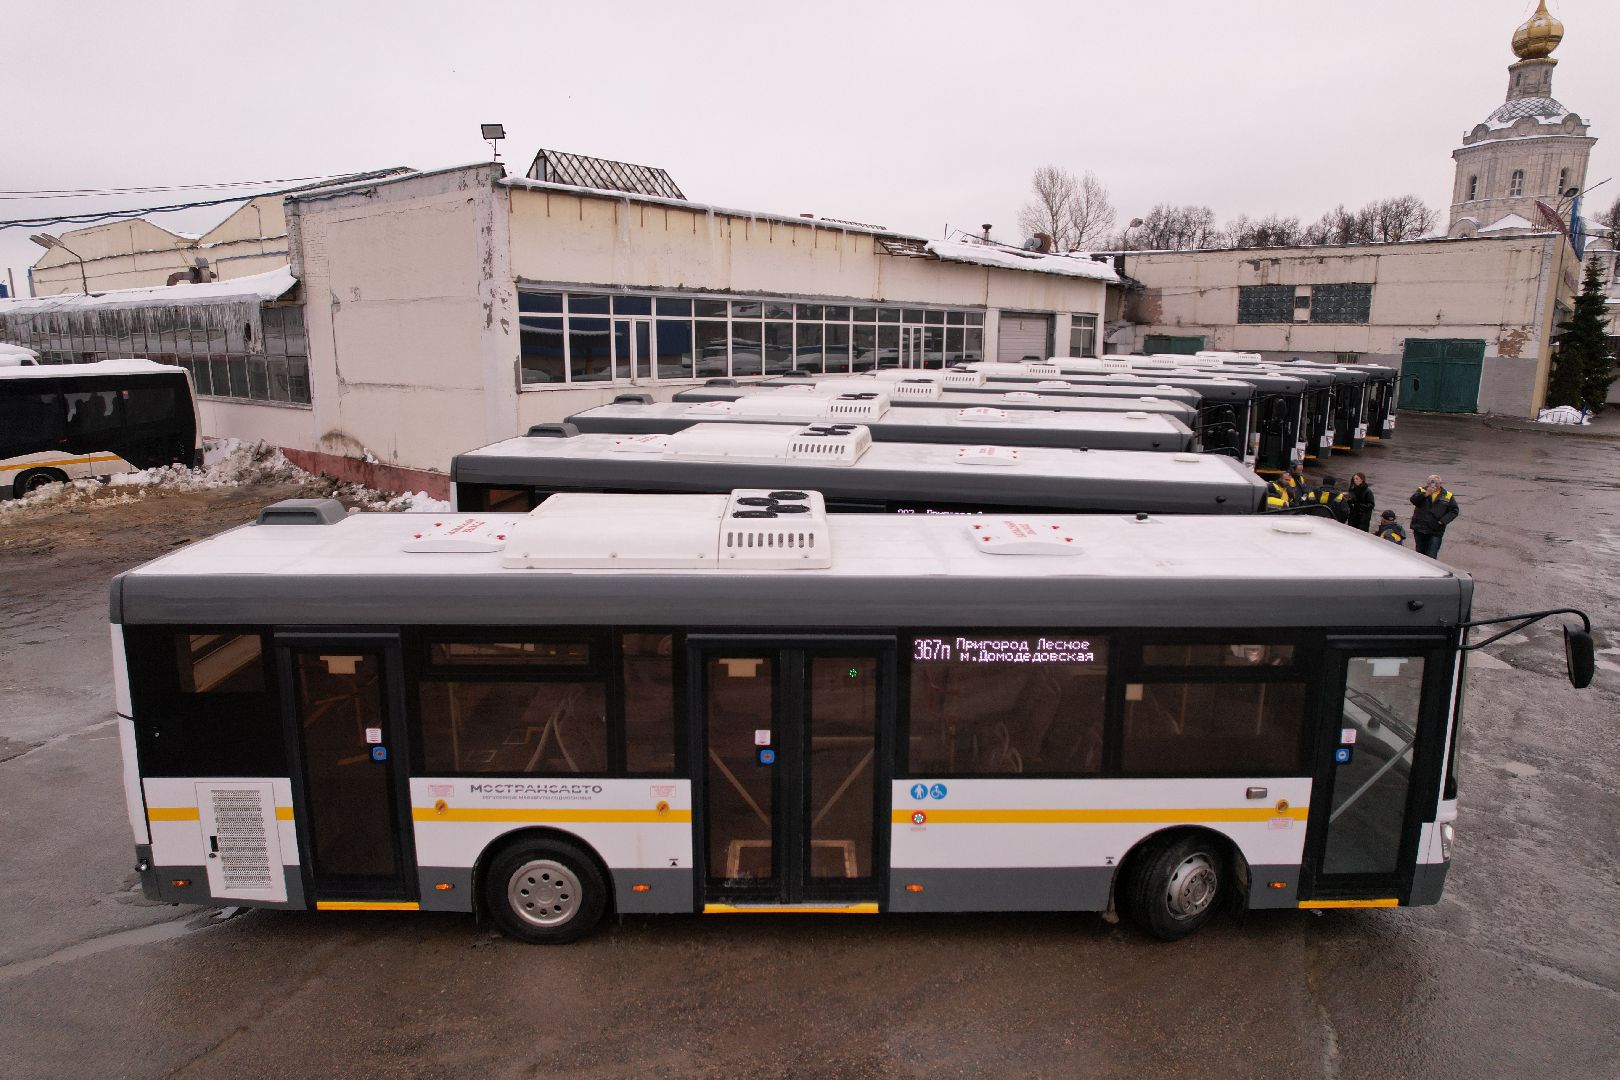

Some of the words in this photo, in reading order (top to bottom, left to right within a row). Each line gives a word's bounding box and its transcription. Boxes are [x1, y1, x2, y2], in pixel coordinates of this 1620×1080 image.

[955, 637, 1029, 651] Пригород
[1037, 637, 1090, 650] Лесное
[470, 784, 603, 794] МОСТРАНСАВТО
